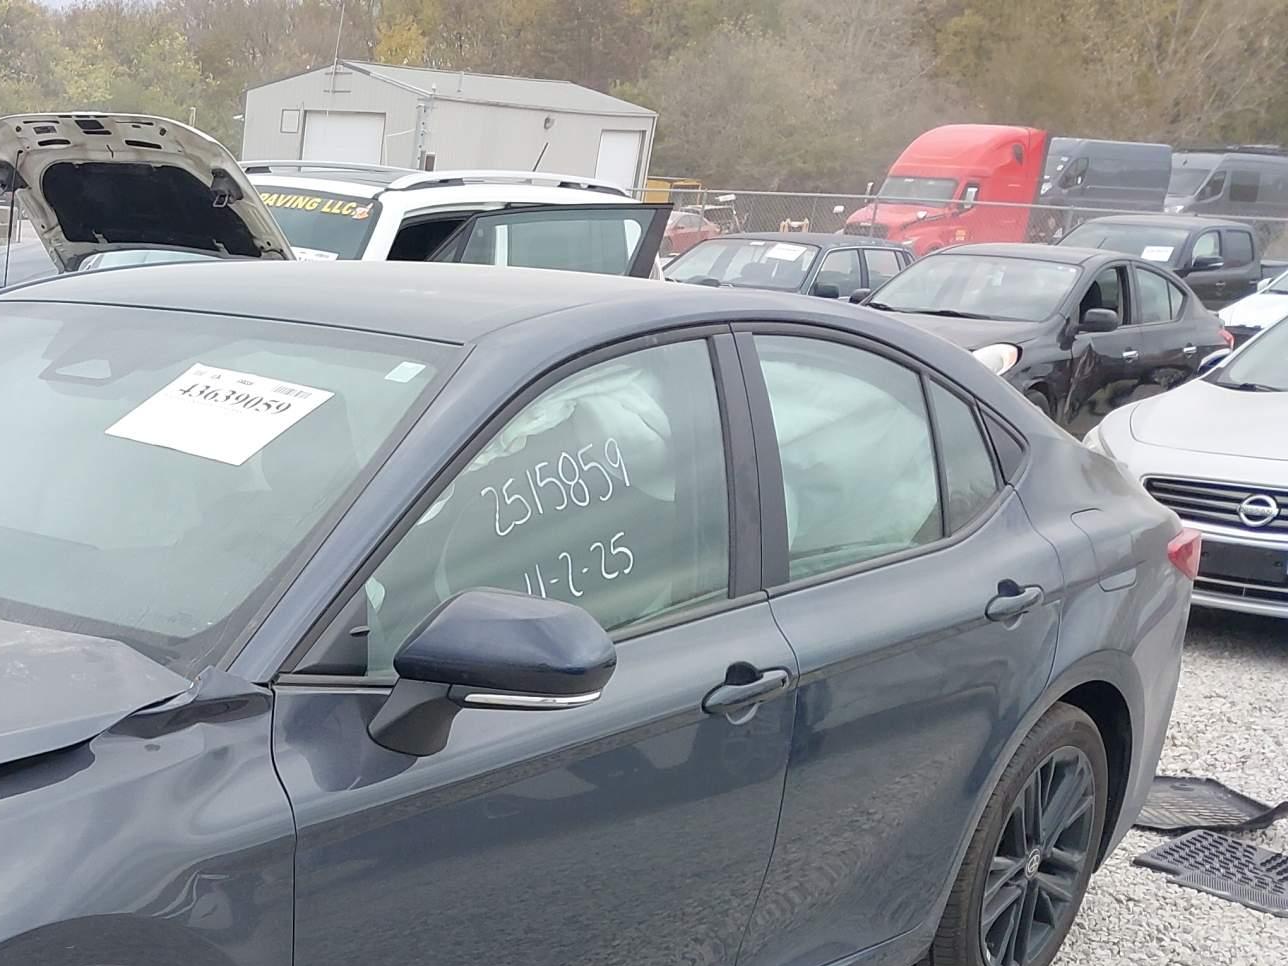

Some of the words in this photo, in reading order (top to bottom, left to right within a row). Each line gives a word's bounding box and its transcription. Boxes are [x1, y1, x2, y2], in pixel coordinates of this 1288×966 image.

[260, 192, 321, 211] PAVING
[178, 383, 292, 415] 43639059
[481, 437, 631, 536] 2515859
[524, 531, 634, 599] 11-2-25
